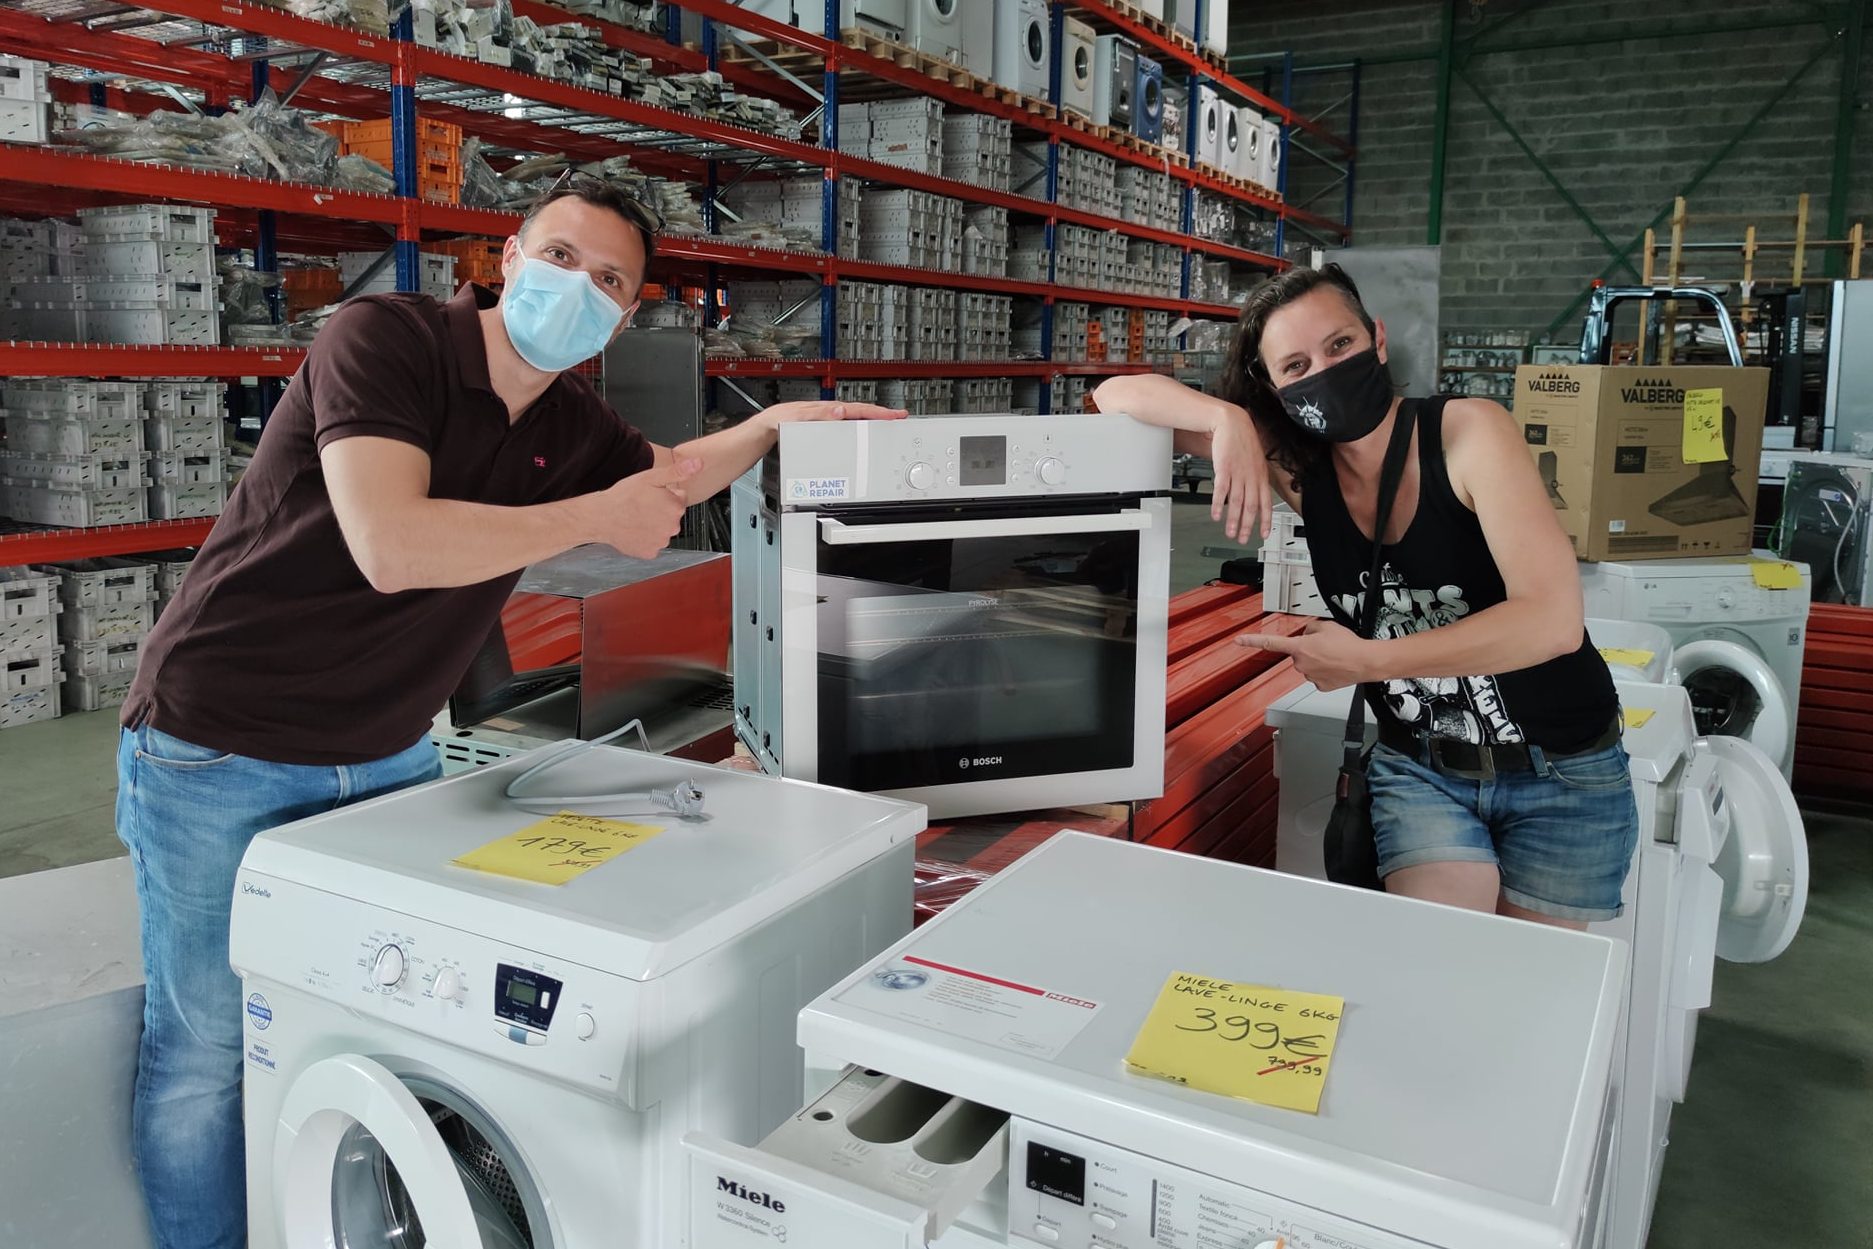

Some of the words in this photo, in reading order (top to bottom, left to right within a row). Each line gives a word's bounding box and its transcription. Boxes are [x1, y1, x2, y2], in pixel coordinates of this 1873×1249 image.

[1788, 317, 1800, 354] NISSAN
[1528, 380, 1580, 393] VALBERG
[1621, 388, 1685, 404] VALBERG
[809, 480, 846, 490] PLANET
[809, 488, 845, 498] REPAIR
[973, 756, 1003, 767] BOSCH
[517, 836, 611, 858] 179€
[1178, 975, 1233, 991] MIELE
[1298, 1009, 1339, 1021] 6KG
[1175, 1007, 1328, 1058] 399€
[717, 1175, 786, 1213] Miele
